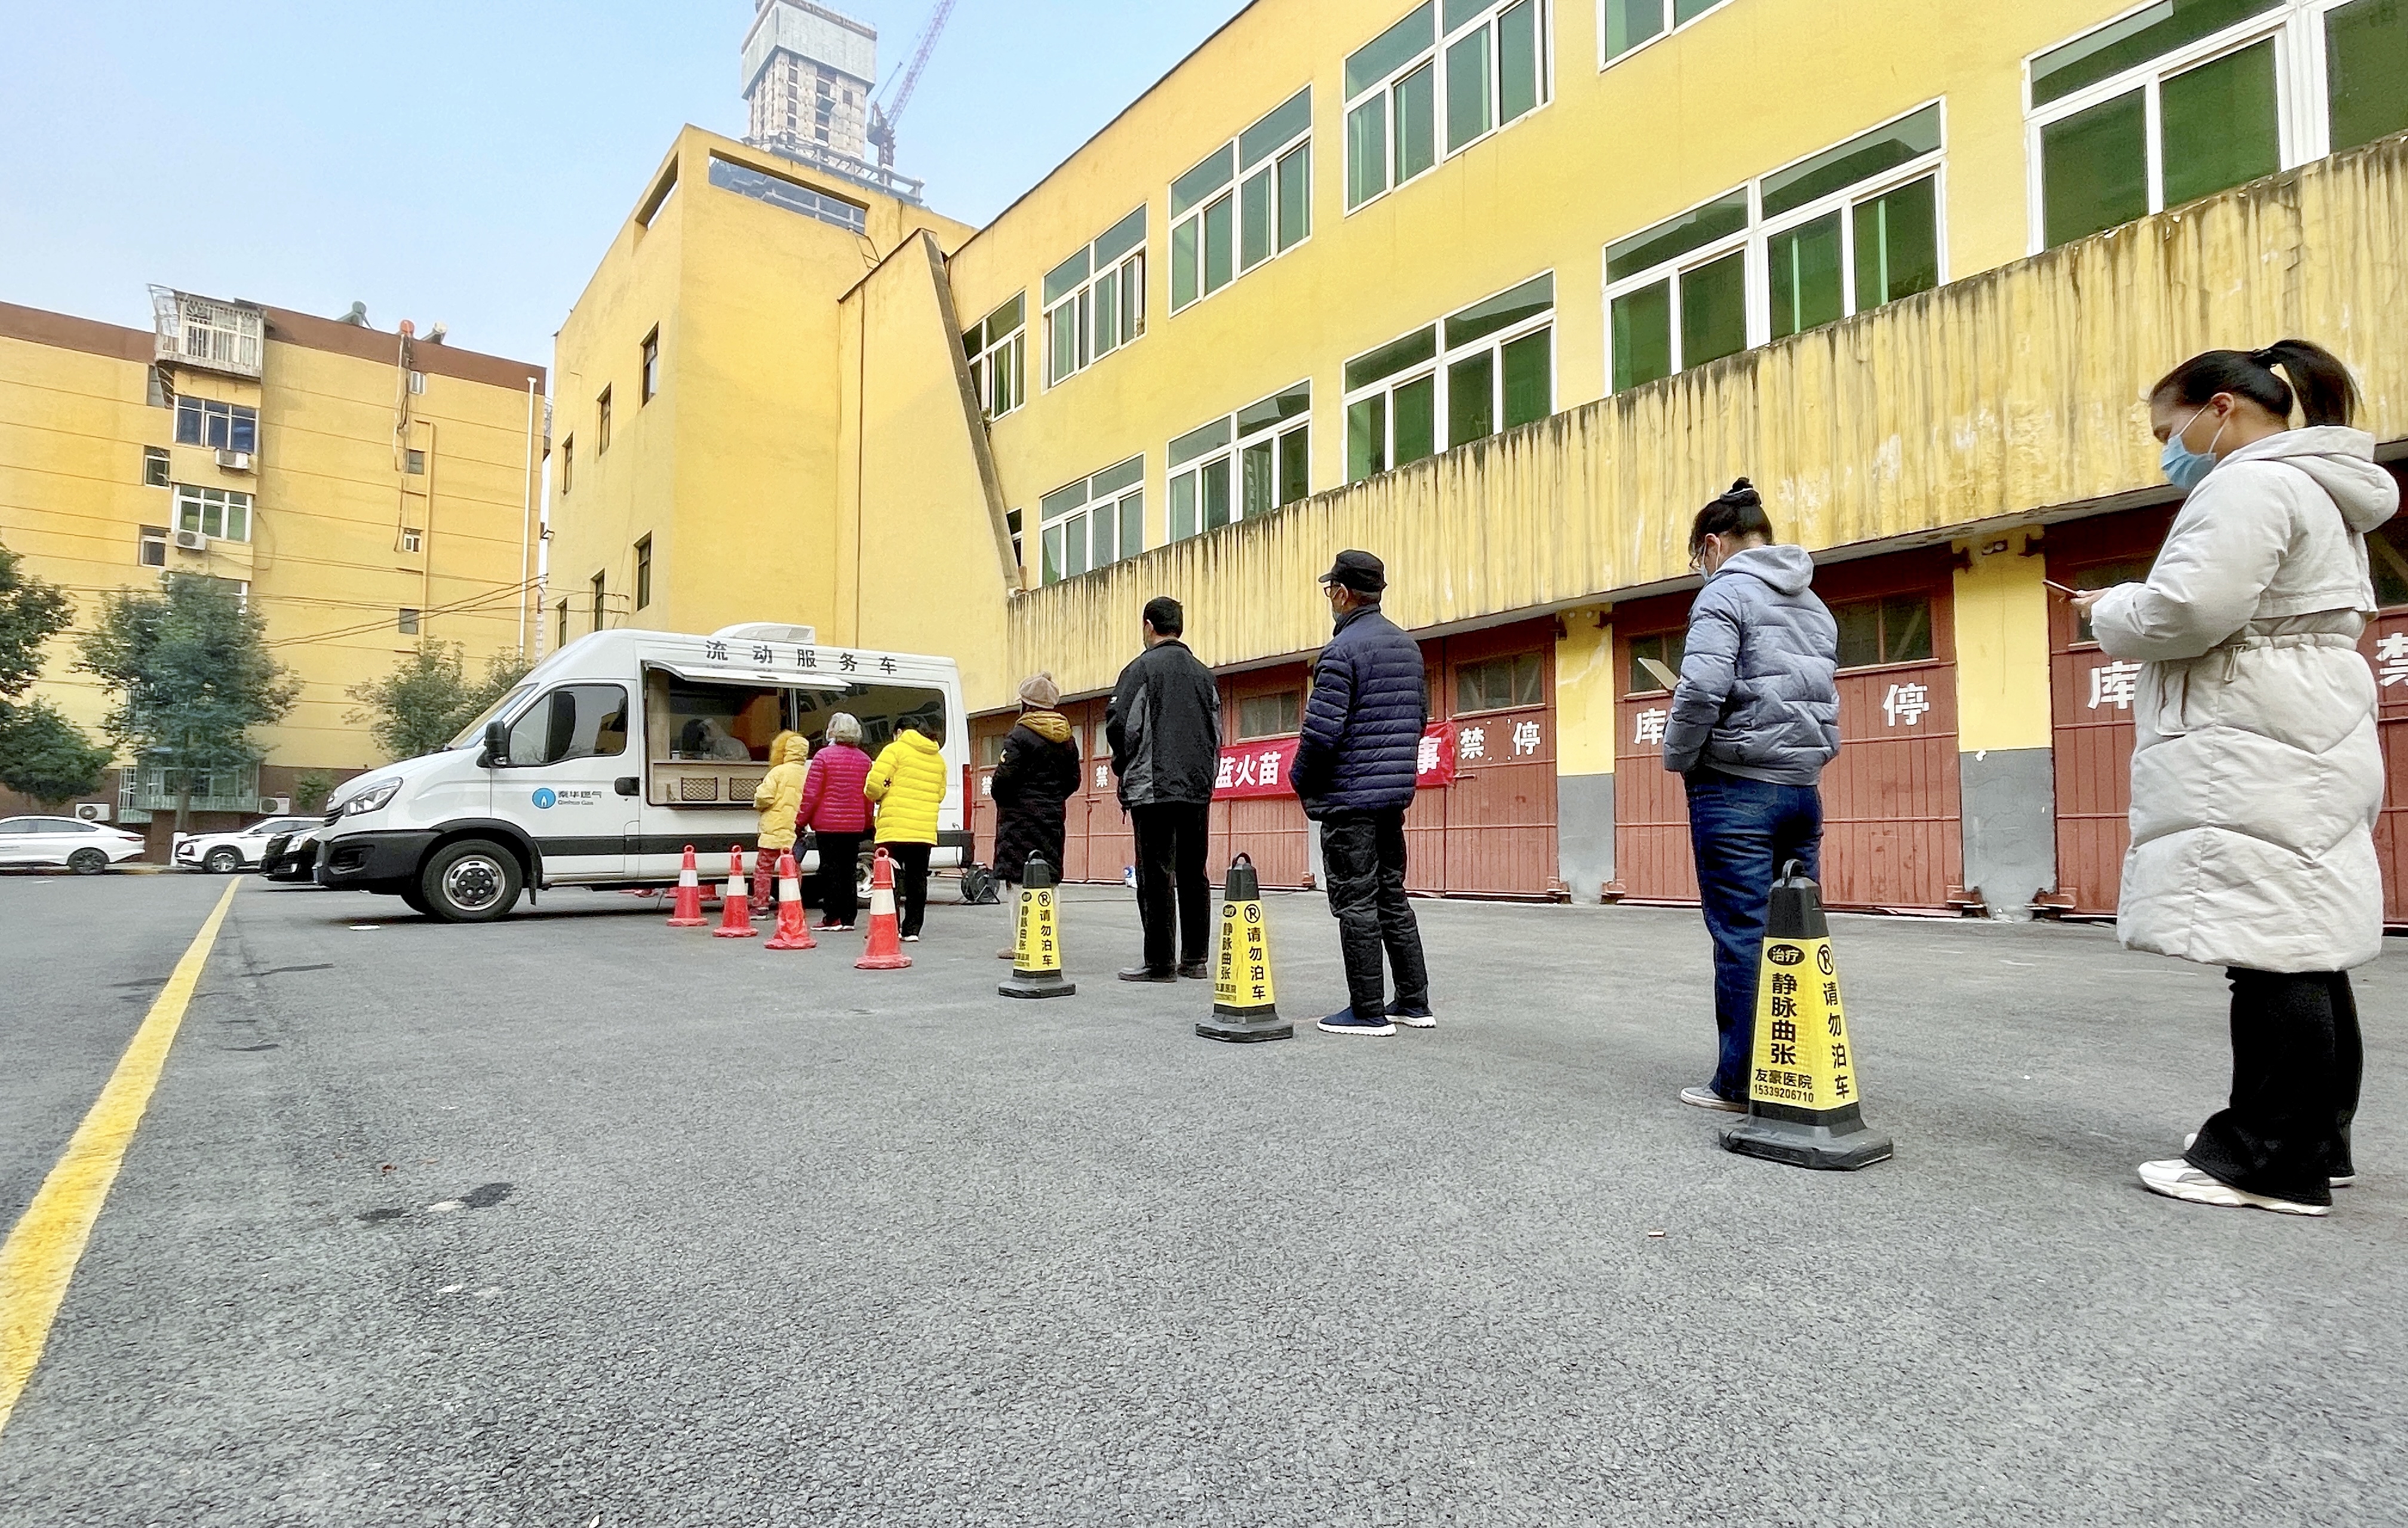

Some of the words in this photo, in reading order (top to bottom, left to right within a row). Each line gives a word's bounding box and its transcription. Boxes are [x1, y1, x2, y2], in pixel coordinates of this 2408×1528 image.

[706, 640, 897, 674] 流动服务车
[1882, 682, 1930, 727] 停
[2087, 660, 2143, 709] 库
[1095, 764, 1108, 788] 禁
[1215, 751, 1282, 789] 蓝火苗
[1417, 736, 1442, 774] 事
[1040, 909, 1054, 966] 请勿泊车
[1771, 948, 1799, 963] 治疗
[1247, 926, 1266, 1000] 请勿泊车
[1771, 973, 1798, 1065] 静脉曲张
[1823, 981, 1850, 1099] 请勿泊车
[1754, 1084, 1814, 1103] 15339206710
[1755, 1068, 1813, 1090] 友豪医院
